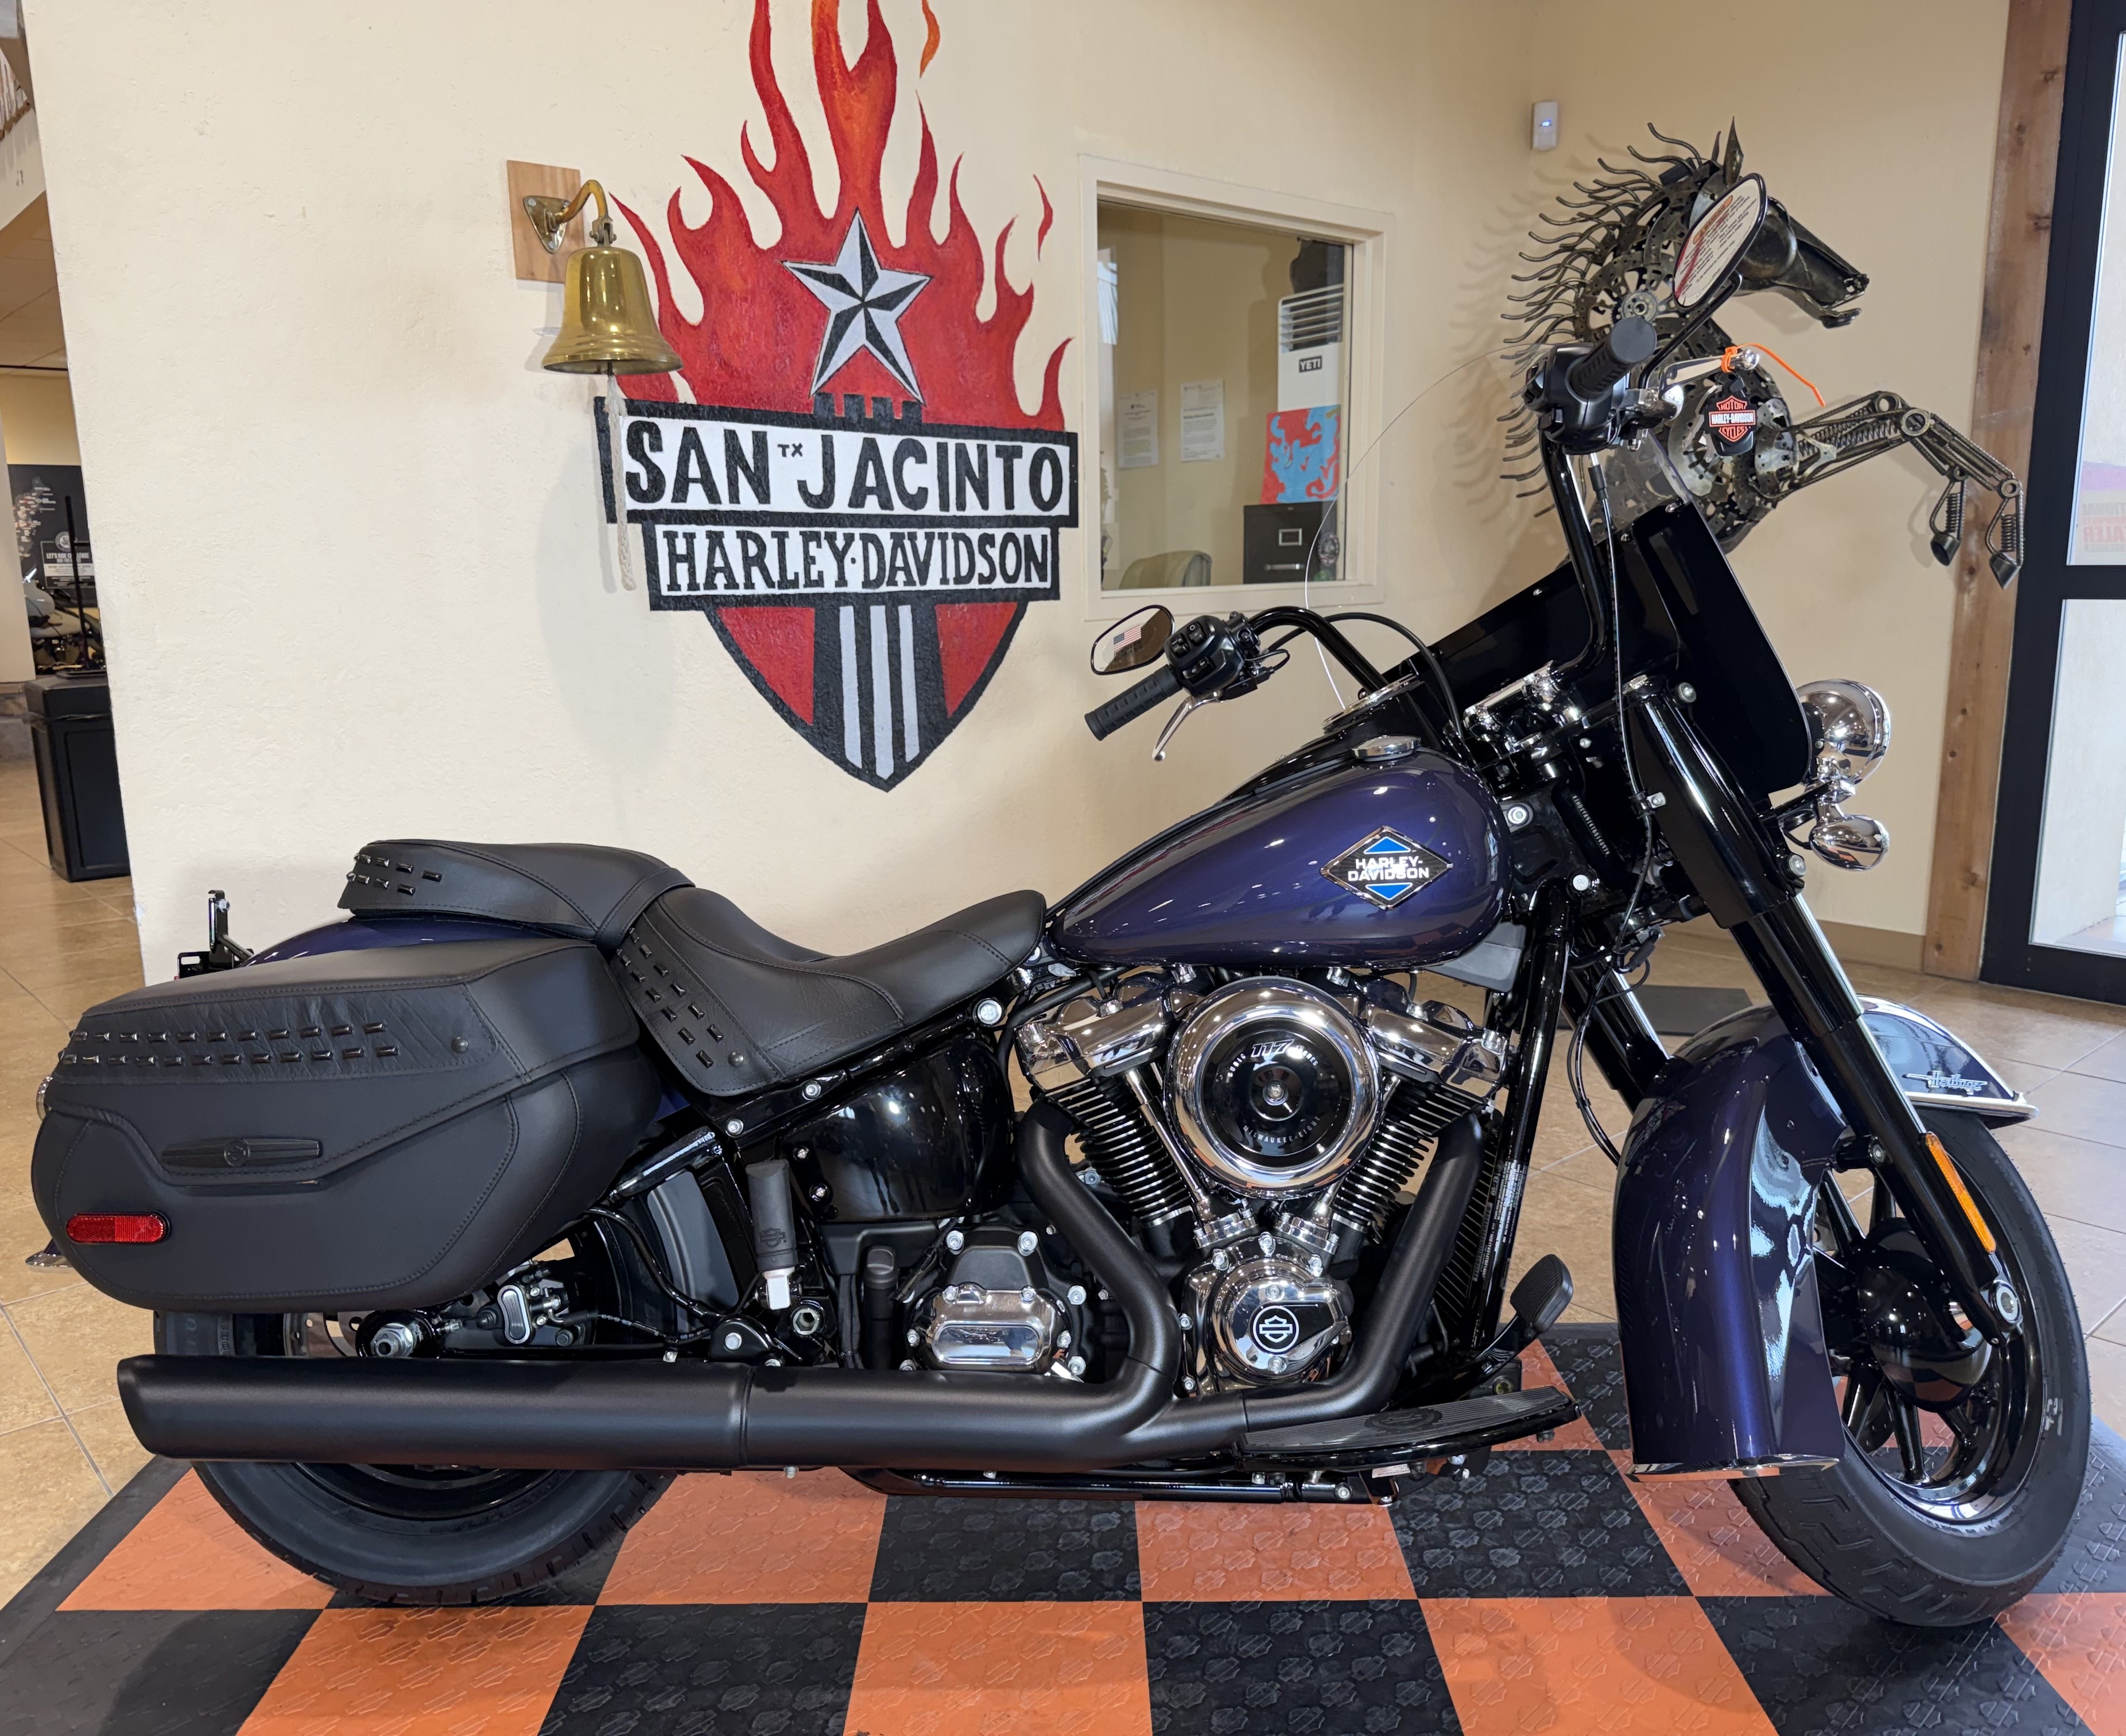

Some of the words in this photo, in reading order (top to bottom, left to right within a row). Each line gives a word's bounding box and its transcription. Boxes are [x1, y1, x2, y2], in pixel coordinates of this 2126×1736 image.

[1299, 358, 1321, 370] YETI
[1720, 401, 1743, 411] MOTOR
[1711, 412, 1753, 424] HARLEY-DAVIDSON
[1722, 426, 1746, 439] CYCLES
[625, 420, 771, 505] SAN
[777, 443, 803, 458] TX
[797, 435, 1065, 512] JACINTO
[1355, 856, 1423, 869] HARLEY-
[1348, 867, 1429, 882] DAVIDSON
[1227, 1053, 1247, 1078] CUBIC
[1250, 1038, 1295, 1057] 117
[1242, 1115, 1320, 1144] MILWAUKEE-EIGHT
